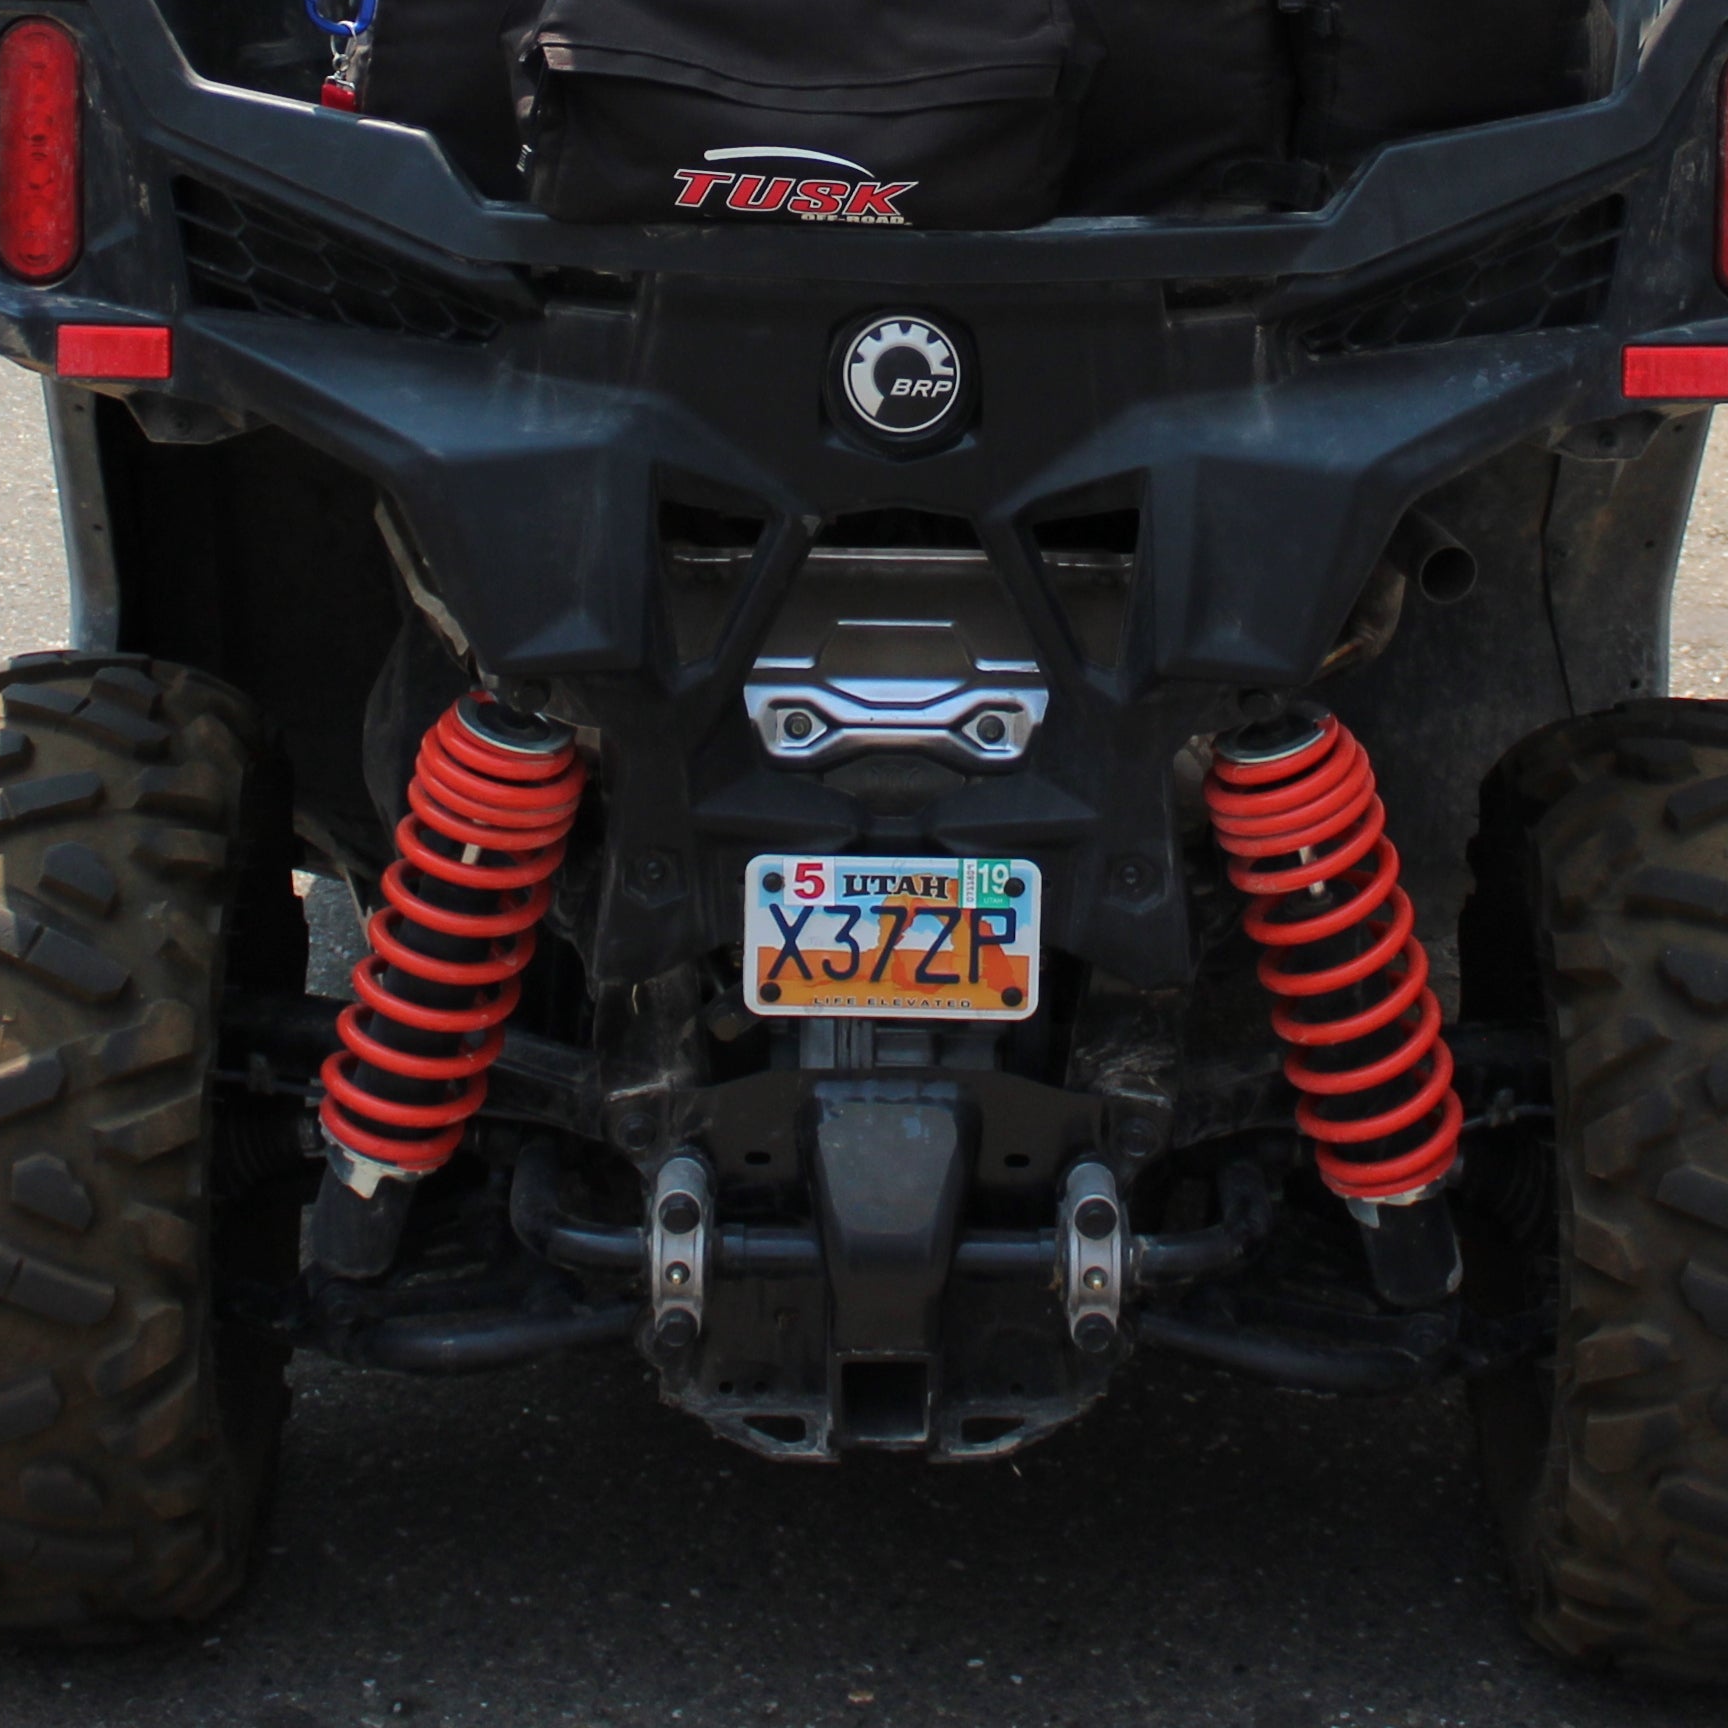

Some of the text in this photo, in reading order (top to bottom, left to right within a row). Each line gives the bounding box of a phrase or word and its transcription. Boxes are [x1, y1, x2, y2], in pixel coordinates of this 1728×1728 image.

[673, 168, 919, 216] TUSK
[890, 378, 953, 398] BRP
[793, 862, 825, 900] 5
[842, 873, 950, 900] UTAH
[978, 863, 1010, 894] 19
[813, 996, 972, 1009] LIFE ELEVATED
